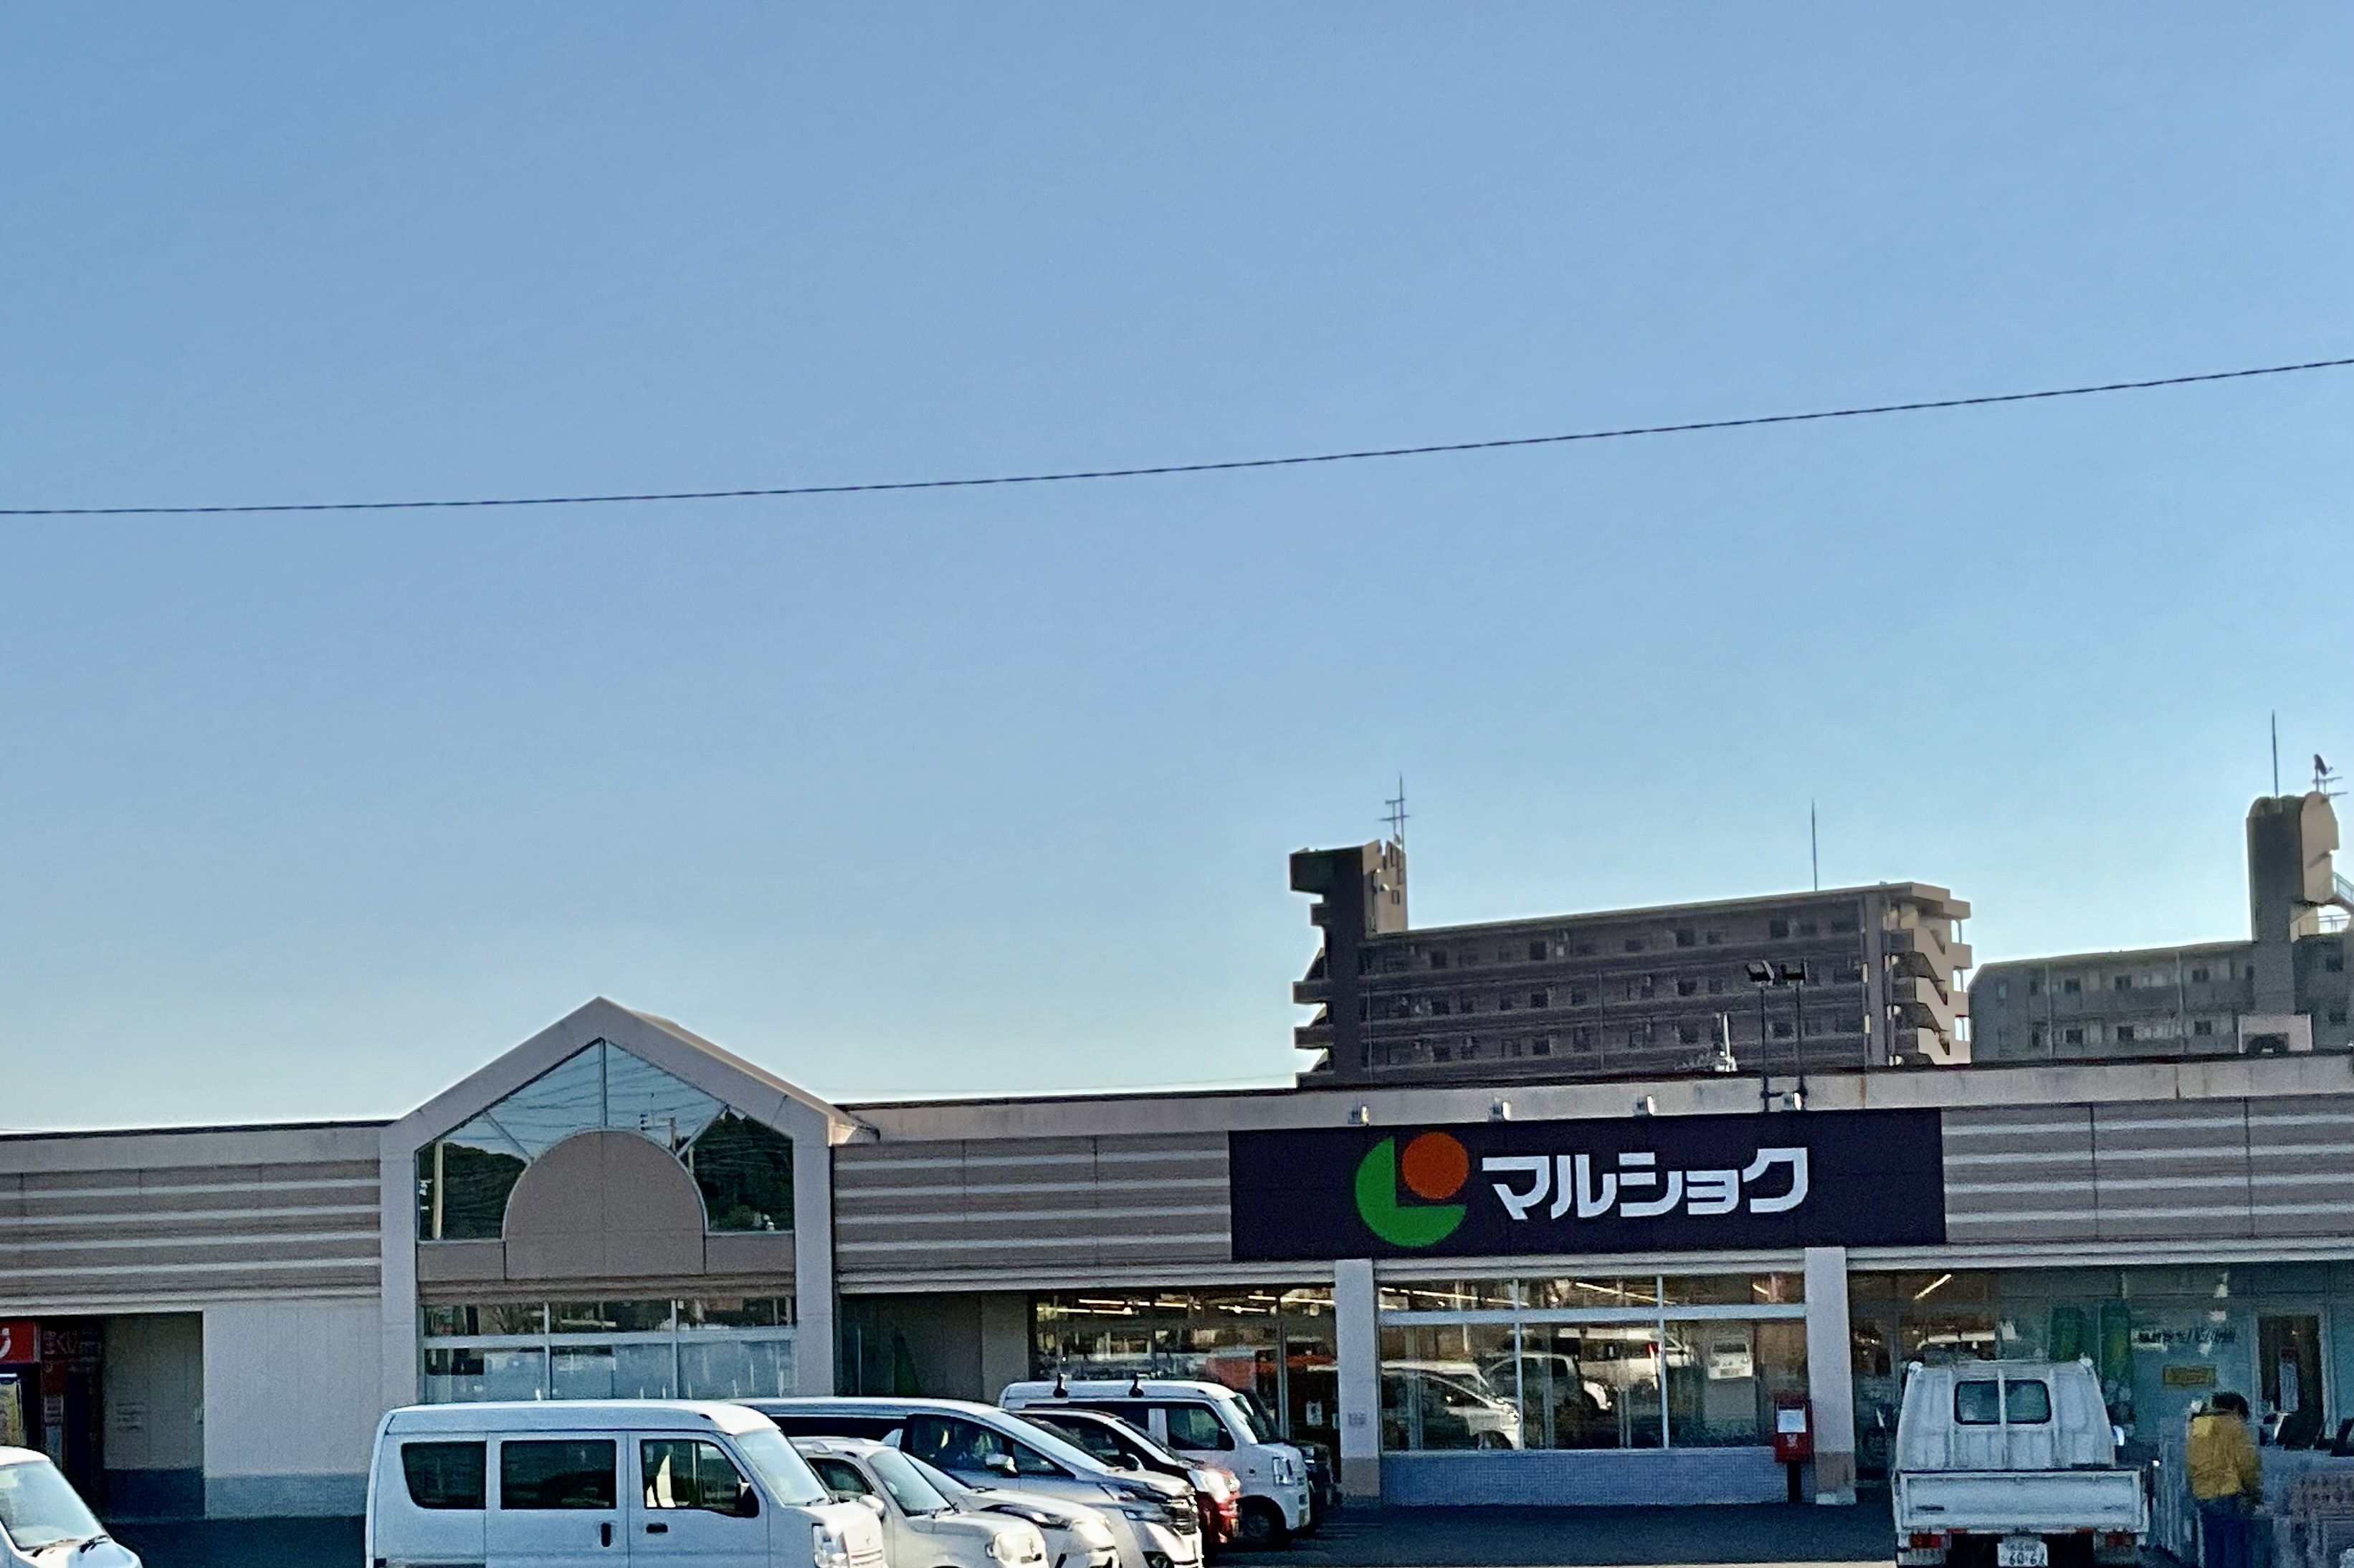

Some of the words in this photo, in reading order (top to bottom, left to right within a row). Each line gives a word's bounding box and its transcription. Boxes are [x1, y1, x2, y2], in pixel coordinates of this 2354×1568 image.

[1481, 1147, 1809, 1220] マルショク
